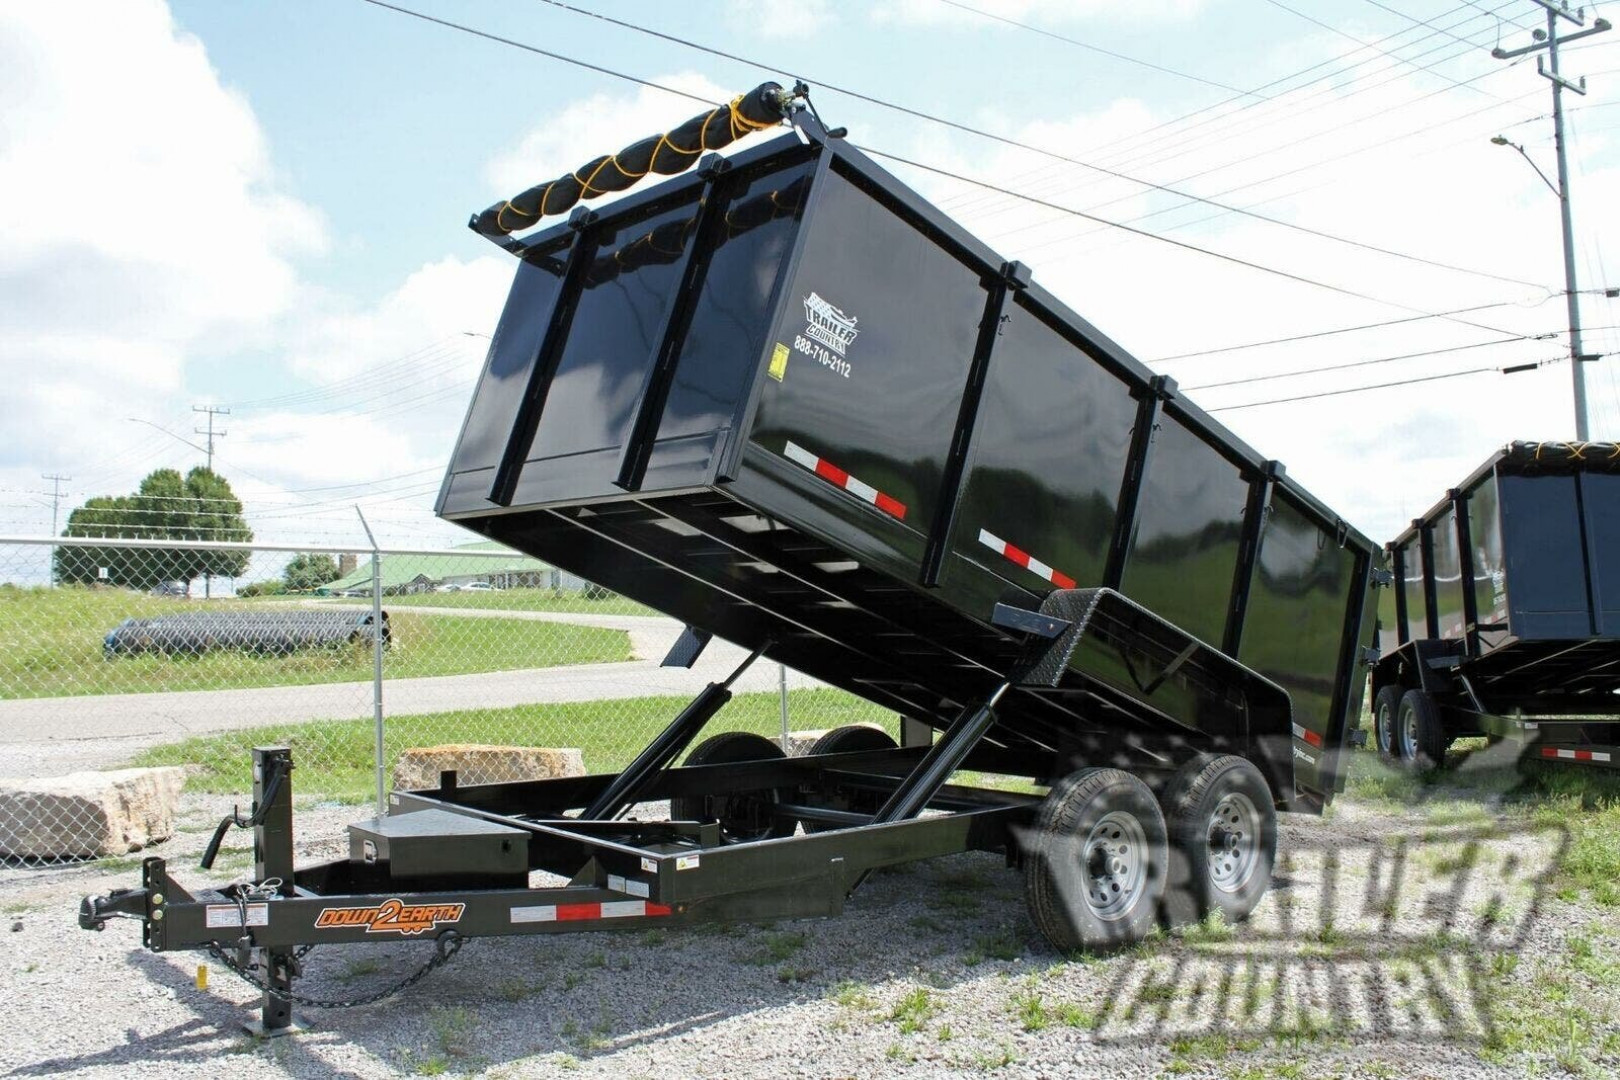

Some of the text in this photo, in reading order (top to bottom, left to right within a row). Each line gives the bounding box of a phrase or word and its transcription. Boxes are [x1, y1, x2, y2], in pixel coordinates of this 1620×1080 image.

[804, 303, 856, 344] TRAILER
[807, 324, 846, 353] COUNTRY
[794, 335, 851, 378] 888-710-2112
